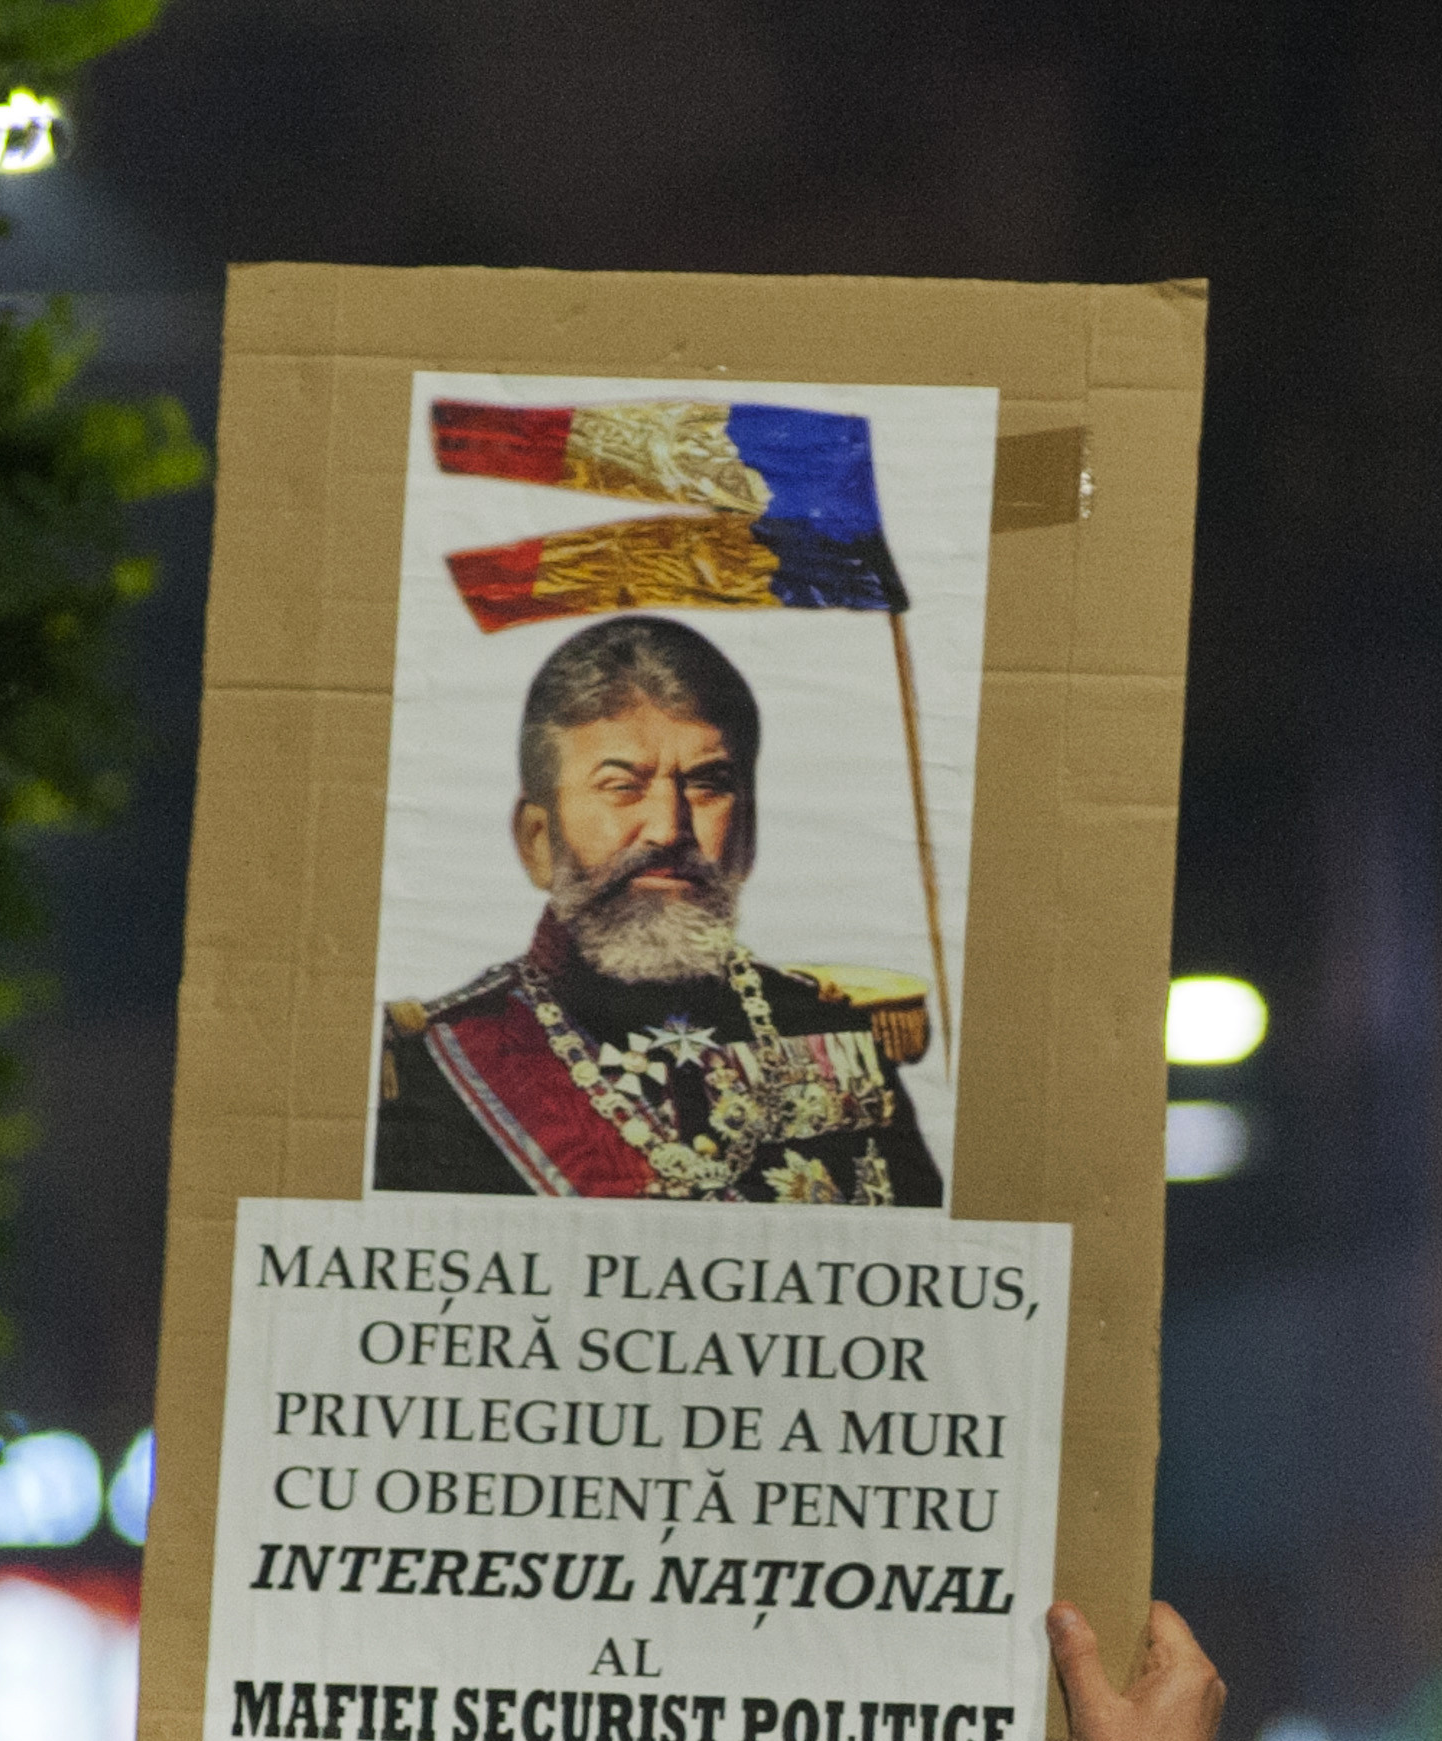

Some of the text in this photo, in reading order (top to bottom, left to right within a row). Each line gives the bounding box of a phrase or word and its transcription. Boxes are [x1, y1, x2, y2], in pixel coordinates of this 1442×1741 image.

[259, 1244, 1039, 1321] MAREȘAL PLAGIATORUS,
[360, 1314, 929, 1383] OFERĂ SCLAVILOR
[274, 1393, 1006, 1459] PRIVILEGIUL DE A MURI
[274, 1467, 997, 1545] CU OBEDIENȚĂ PENTRU
[250, 1544, 1015, 1629] INTERESUL NAȚIONAL
[589, 1637, 662, 1678] AL
